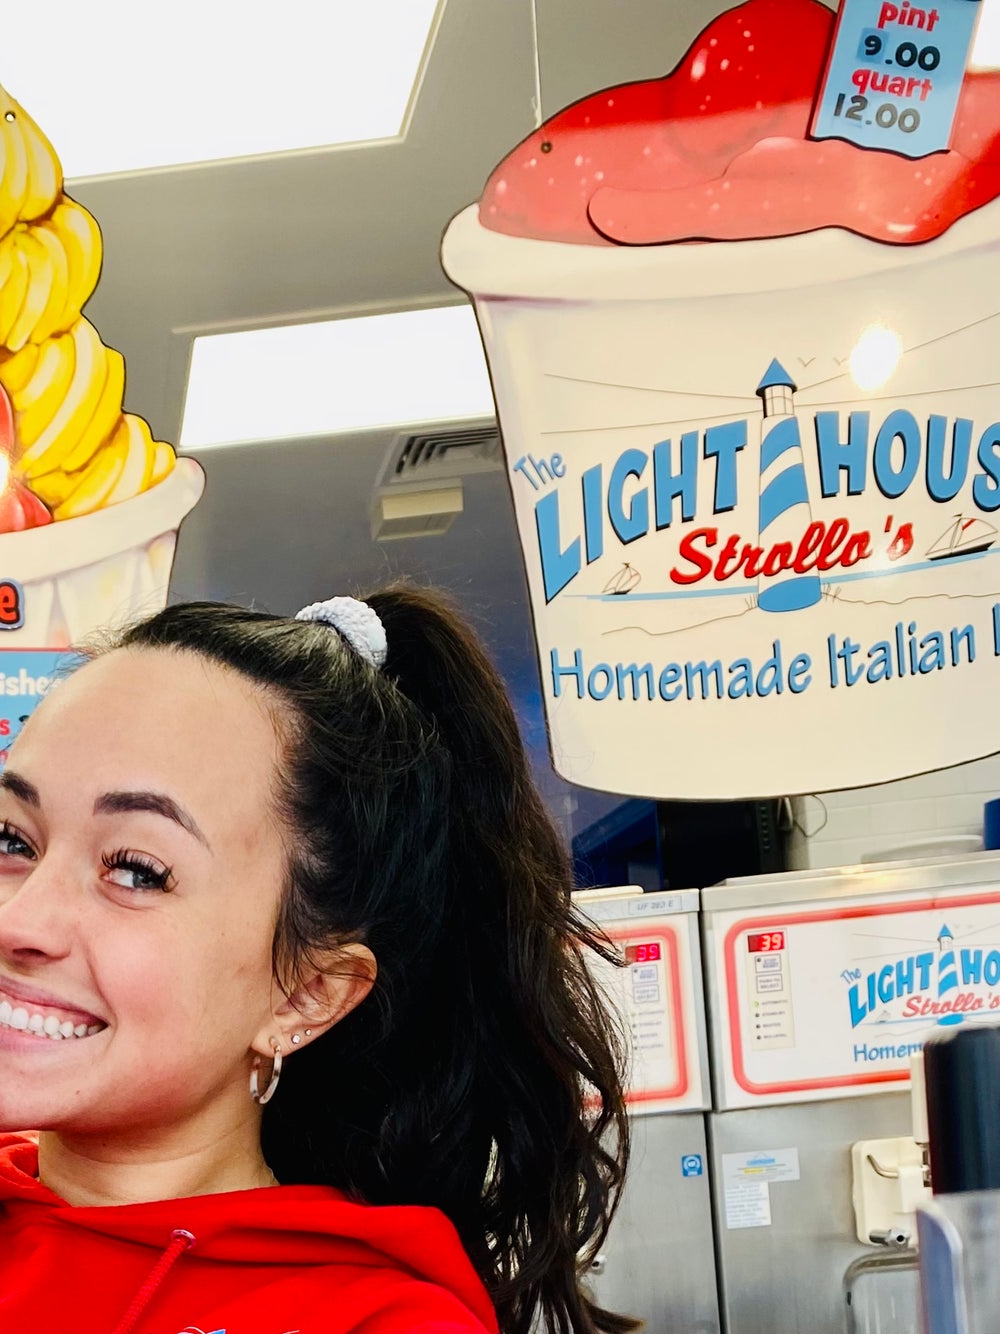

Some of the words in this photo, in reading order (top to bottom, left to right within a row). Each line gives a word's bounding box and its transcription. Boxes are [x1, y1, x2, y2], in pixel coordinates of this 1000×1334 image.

[877, 1, 940, 32] pint
[864, 35, 941, 71] 9.00
[852, 68, 933, 101] quart
[833, 93, 921, 133] 12.00
[513, 452, 567, 490] The
[534, 420, 748, 605] LIGHT
[669, 515, 914, 585] Strollo's
[550, 638, 813, 701] Homemade
[828, 620, 976, 688] Italian
[761, 933, 782, 952] 39
[840, 967, 862, 984] The
[848, 951, 934, 1029] LIGHT
